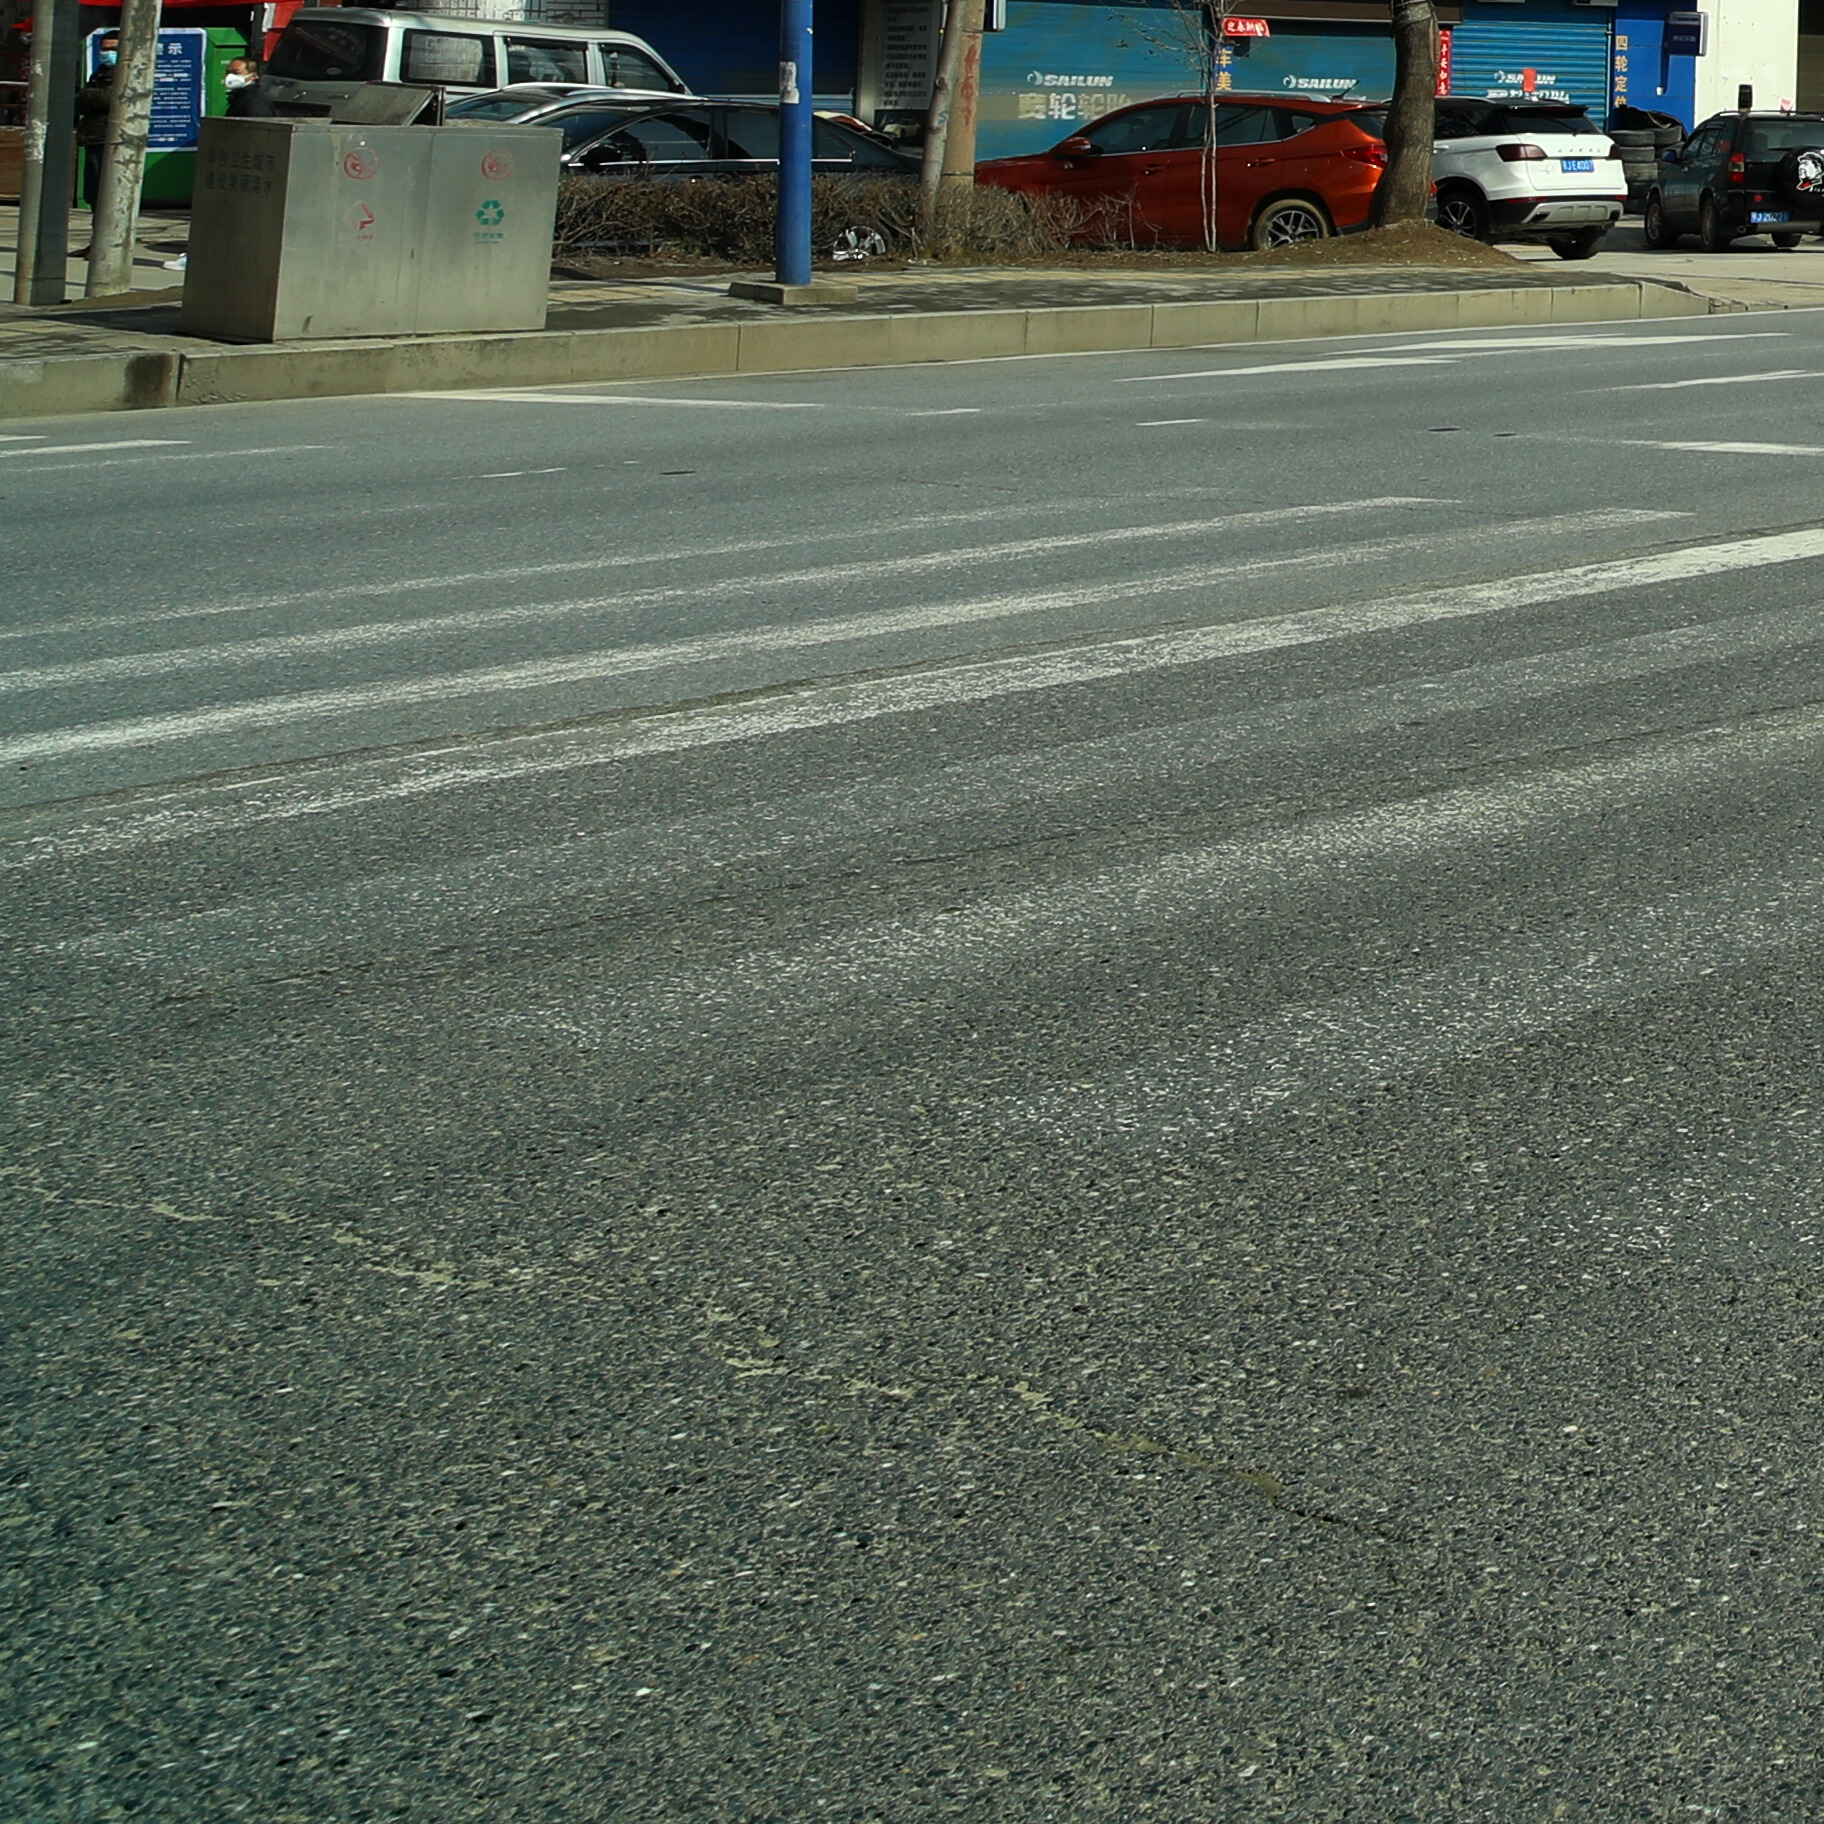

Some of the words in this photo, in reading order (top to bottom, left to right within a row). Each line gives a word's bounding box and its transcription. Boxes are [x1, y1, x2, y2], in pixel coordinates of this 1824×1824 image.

[1614, 35, 1629, 109] 四轮定位
[1043, 74, 1114, 87] SAILUN
[1296, 78, 1357, 90] SAILUN
[1505, 73, 1557, 85] SAUN
